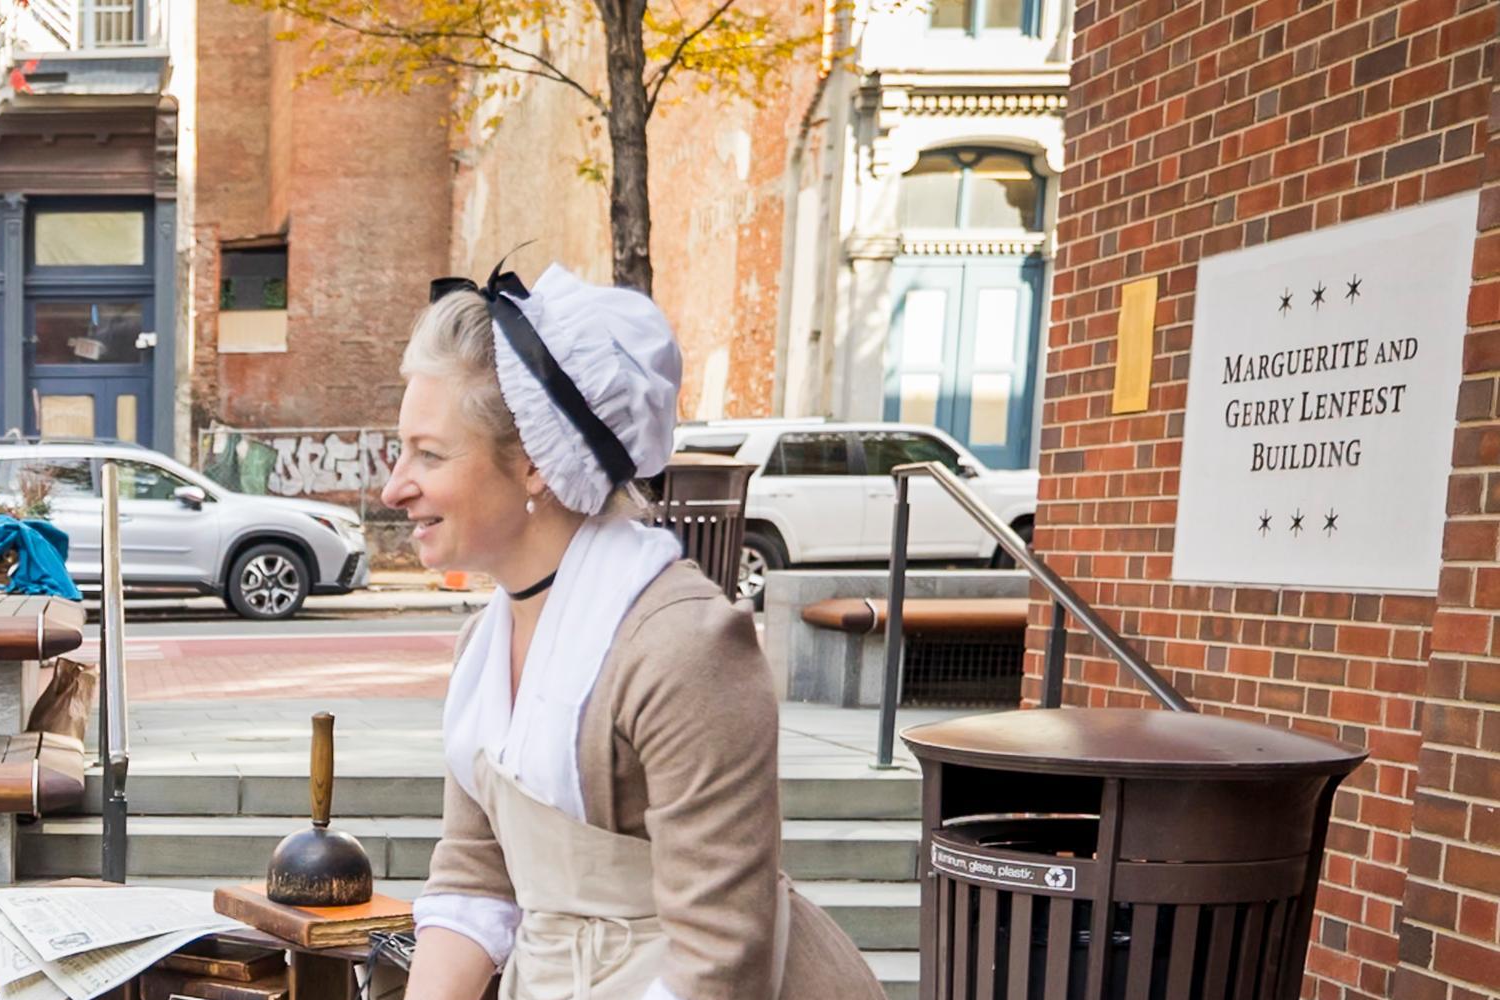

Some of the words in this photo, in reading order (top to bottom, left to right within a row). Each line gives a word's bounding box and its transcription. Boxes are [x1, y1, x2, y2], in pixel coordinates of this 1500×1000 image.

[1222, 338, 1369, 385] MARGUERITE
[1374, 337, 1418, 365] AND
[1225, 397, 1294, 428] GERRY
[1299, 384, 1407, 421] LENFEST
[1251, 439, 1361, 472] BUILDING
